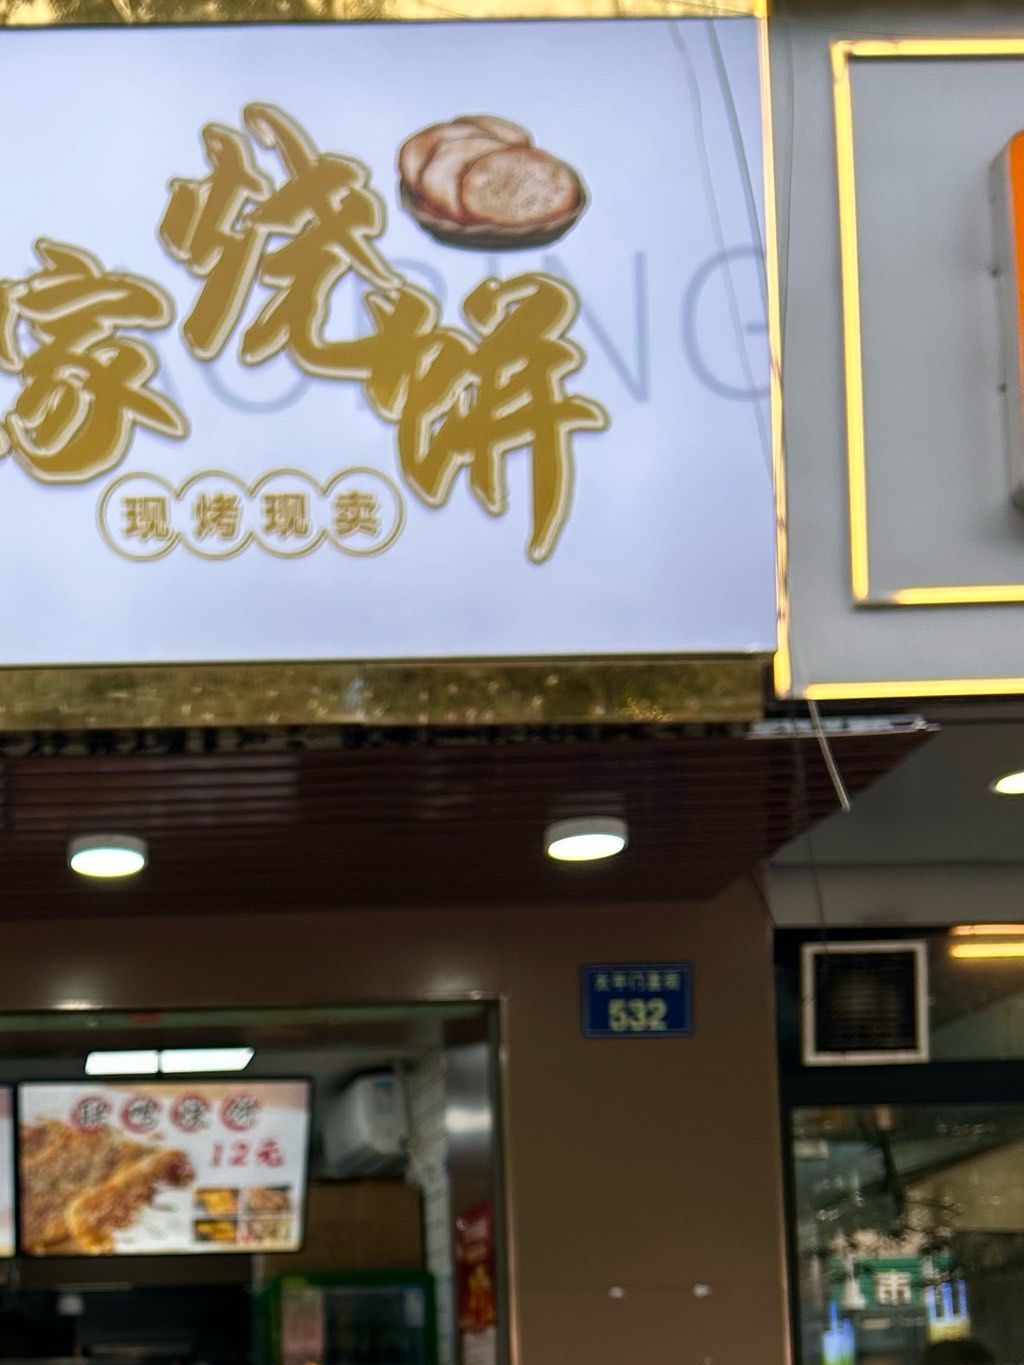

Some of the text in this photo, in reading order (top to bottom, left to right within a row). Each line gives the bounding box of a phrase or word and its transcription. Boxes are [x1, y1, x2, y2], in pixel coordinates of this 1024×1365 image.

[122, 490, 379, 541] 现烤现卖
[608, 998, 667, 1032] 532
